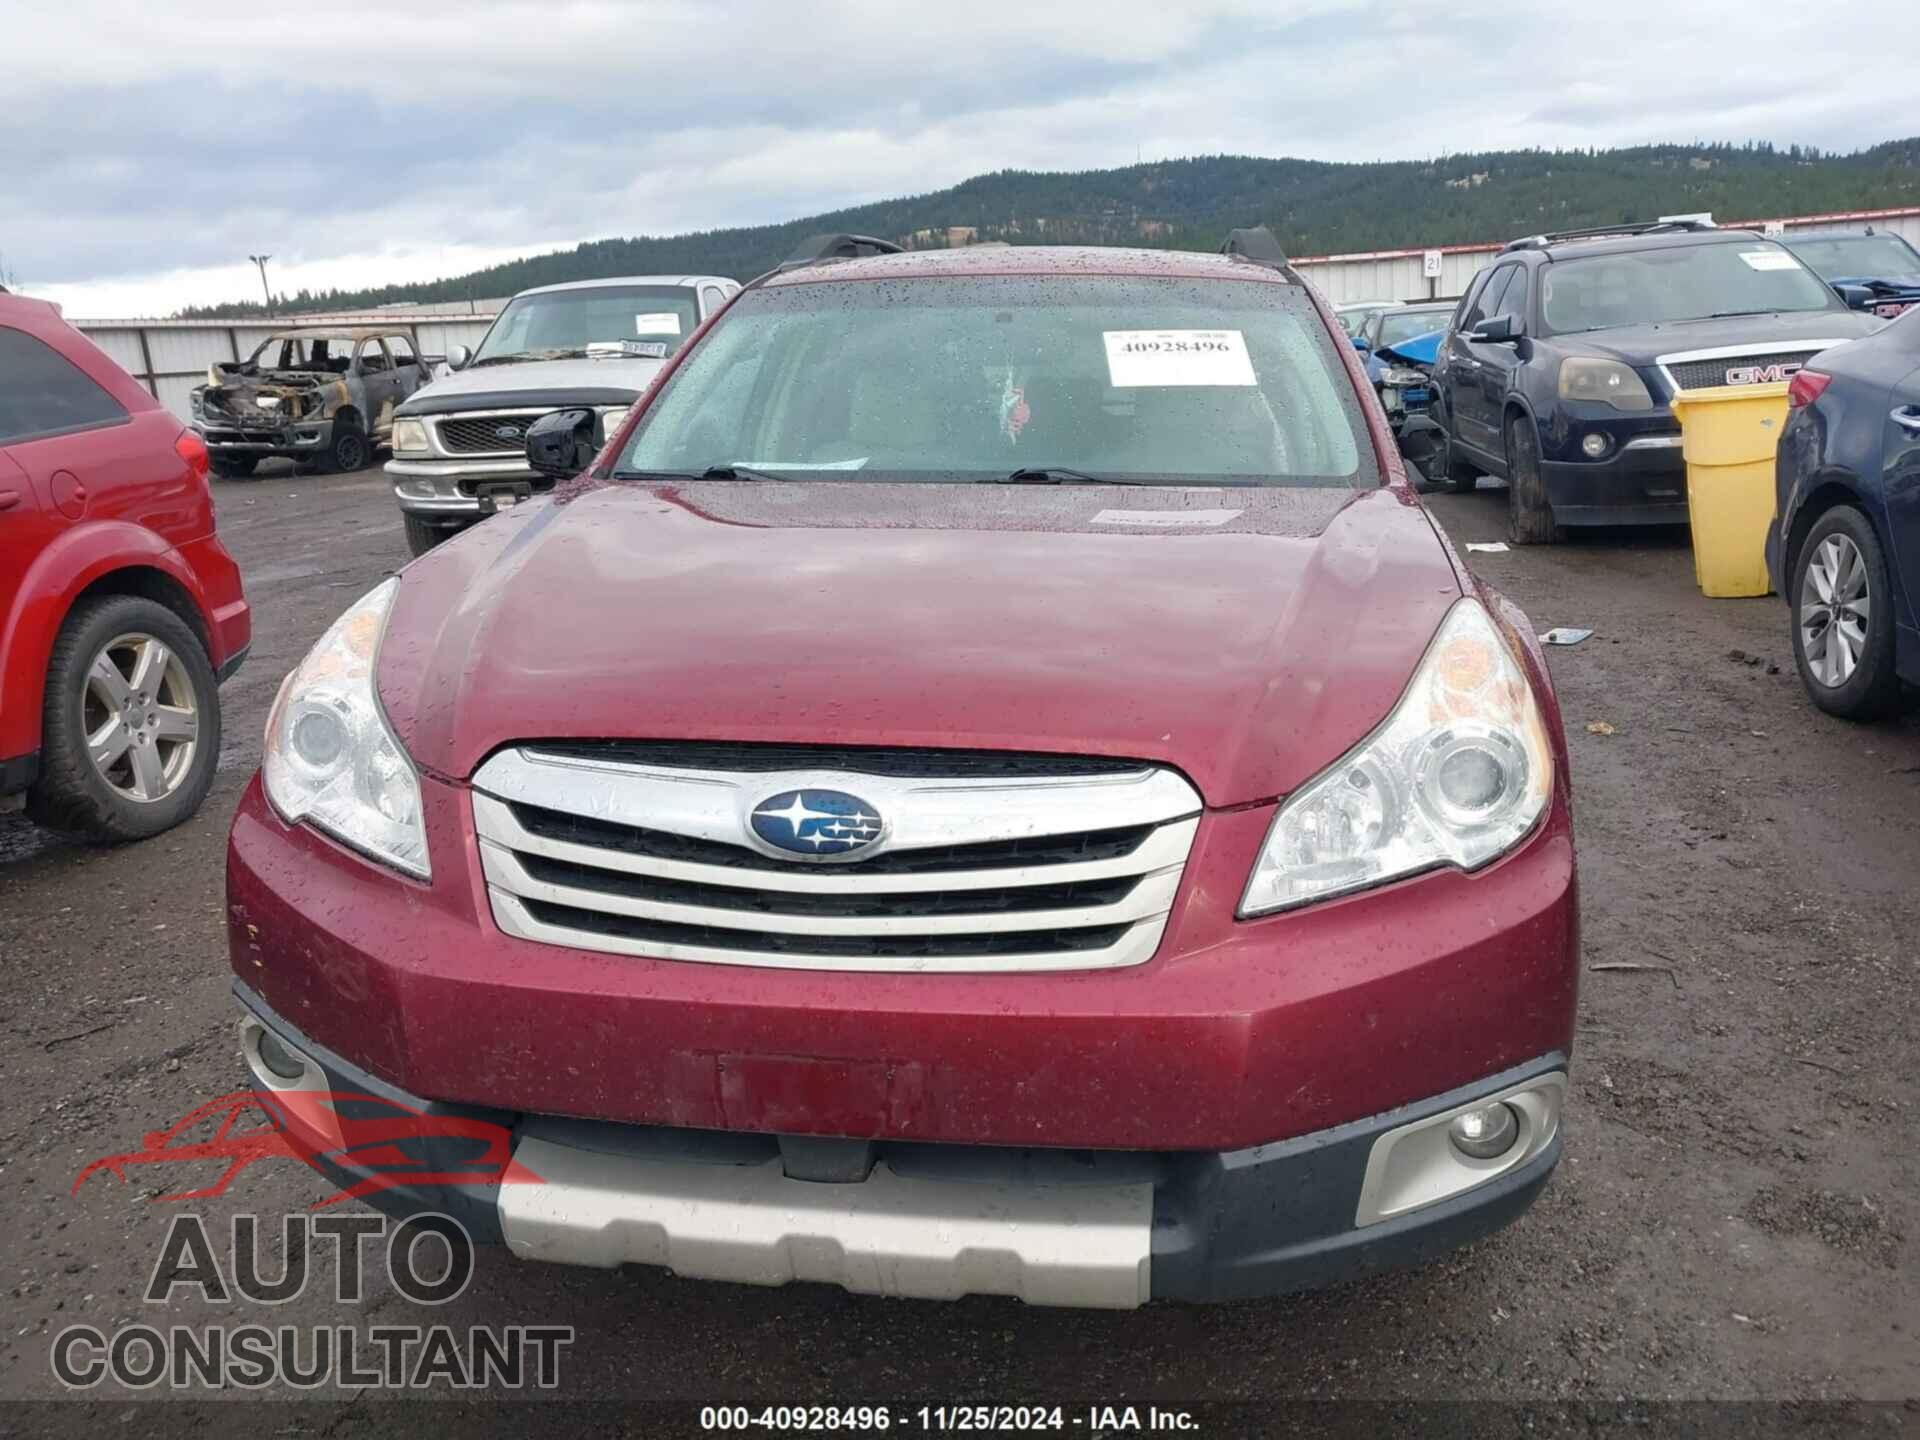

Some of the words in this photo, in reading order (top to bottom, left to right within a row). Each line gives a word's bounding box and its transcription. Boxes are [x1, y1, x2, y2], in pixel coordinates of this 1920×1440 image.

[1427, 256, 1440, 270] 21
[1121, 341, 1230, 353] 40928496
[1726, 363, 1802, 385] GMC
